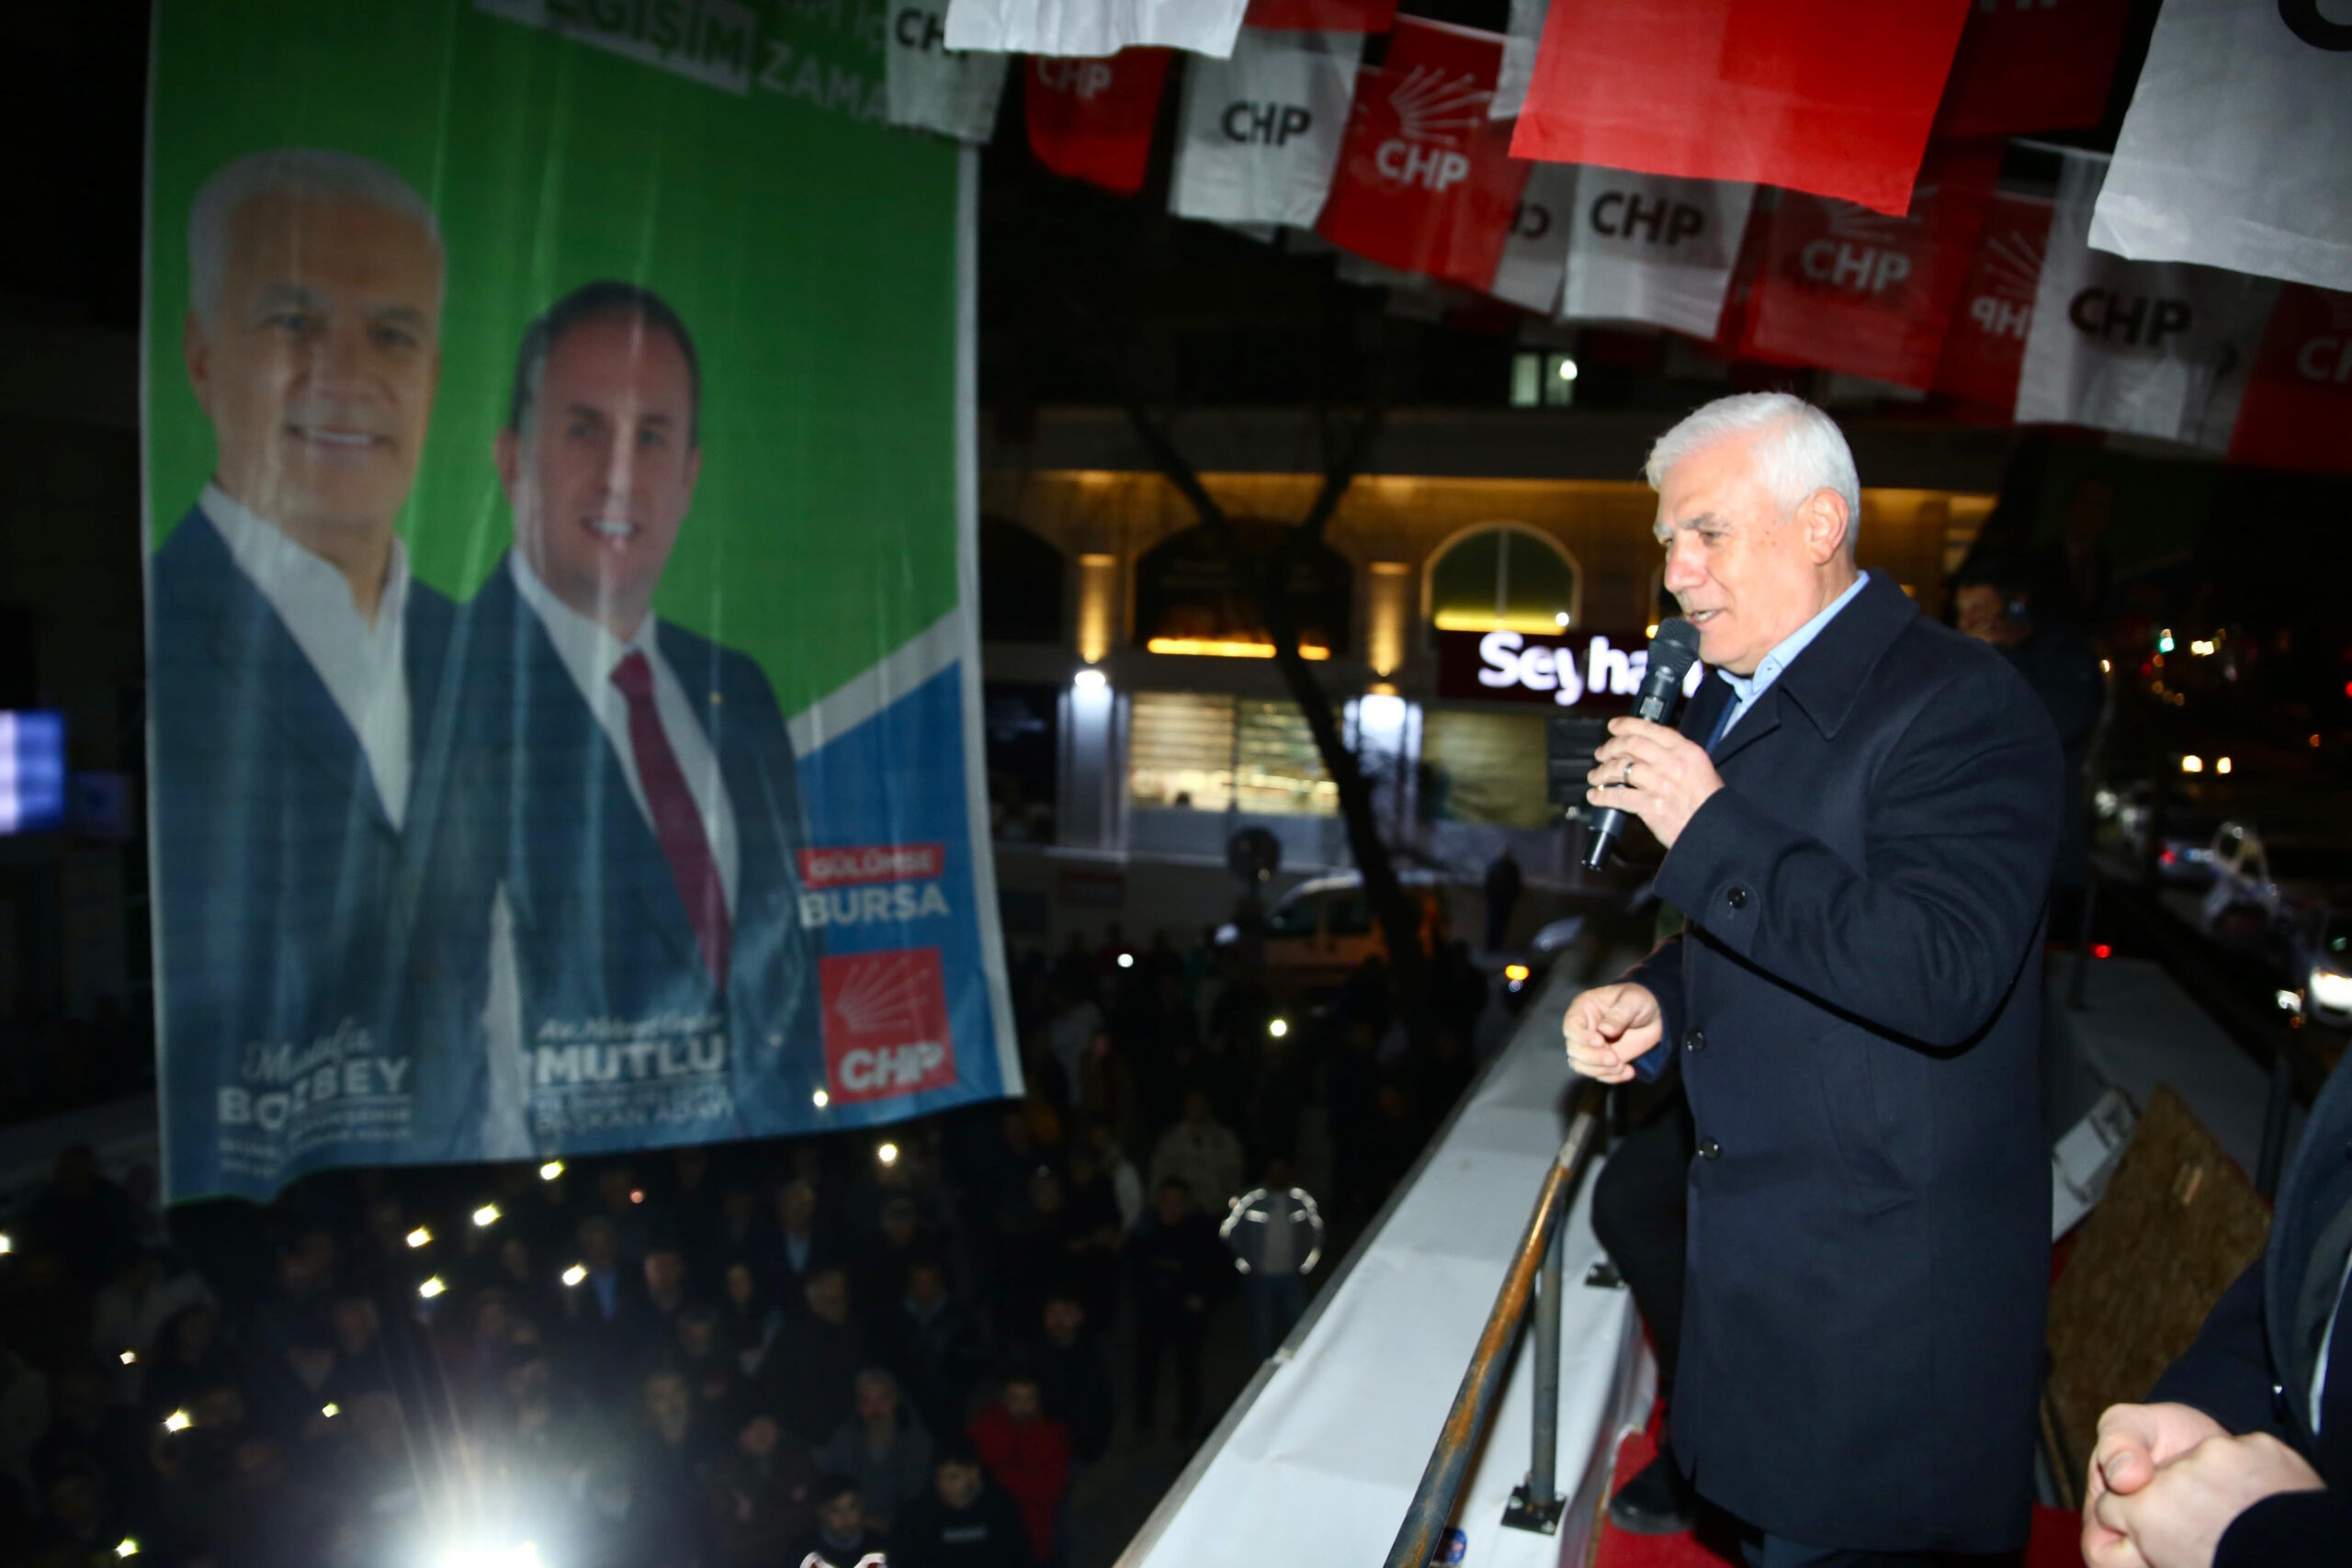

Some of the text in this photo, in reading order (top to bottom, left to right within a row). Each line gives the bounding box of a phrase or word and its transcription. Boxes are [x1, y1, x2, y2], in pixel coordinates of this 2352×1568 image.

[758, 38, 889, 123] ZAMA
[1035, 57, 1114, 100] CHP
[1222, 102, 1311, 146] CHP
[1375, 139, 1470, 193] CHP
[1590, 191, 1703, 246] CHP
[1802, 239, 1912, 295] CHP
[2069, 287, 2193, 347] CHP
[798, 882, 951, 931] BURSA
[537, 1033, 726, 1084] MUTLU
[840, 1040, 944, 1091] CHP
